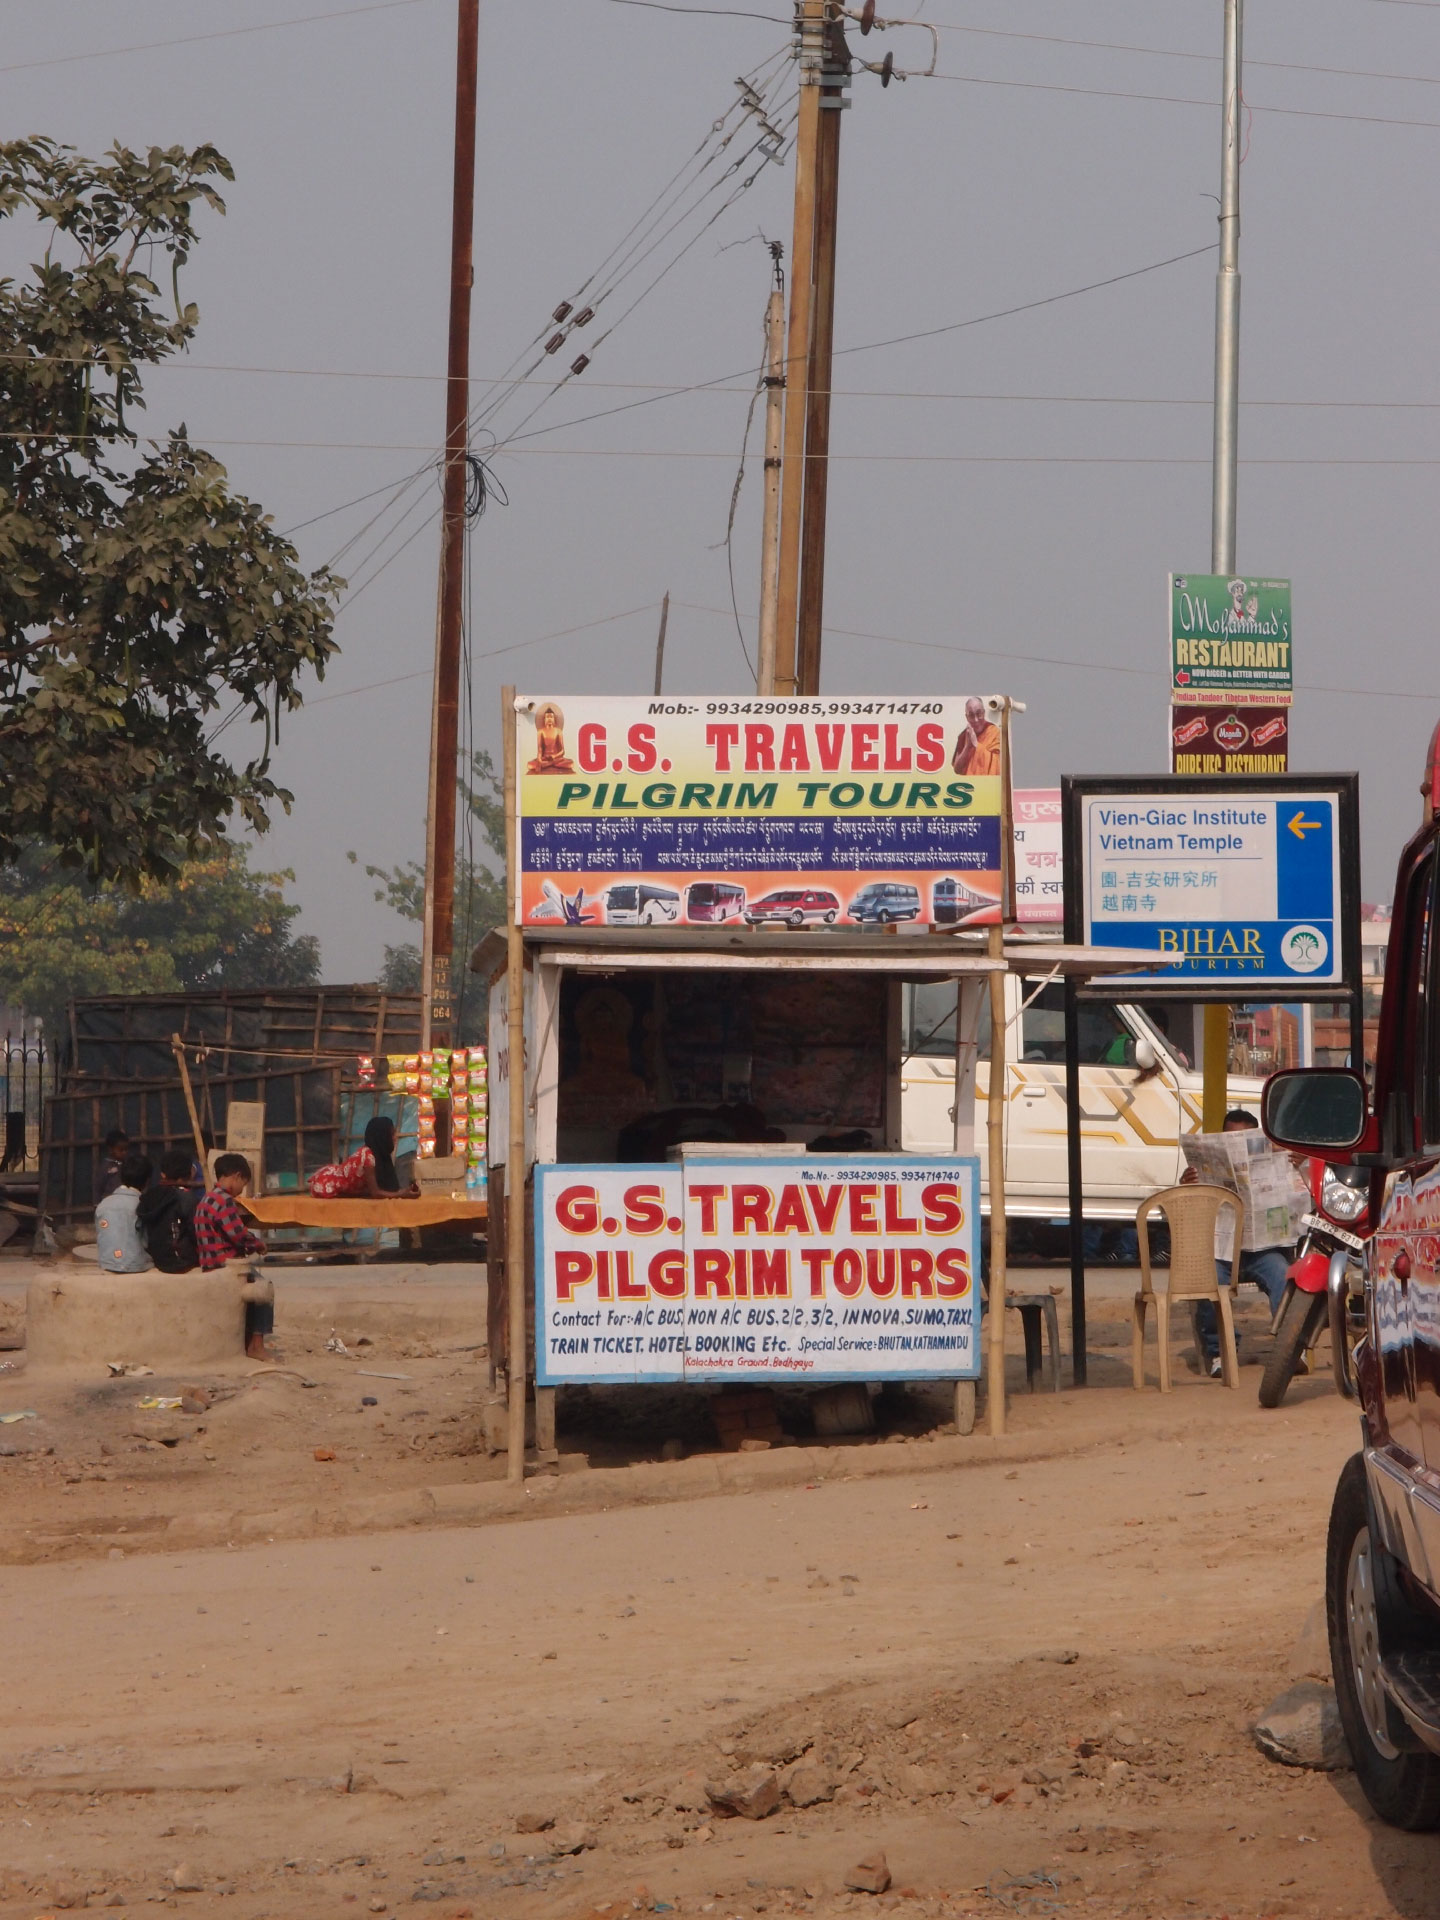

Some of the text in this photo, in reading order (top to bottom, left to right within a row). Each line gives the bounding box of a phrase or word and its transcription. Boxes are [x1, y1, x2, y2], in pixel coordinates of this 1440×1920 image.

[1179, 592, 1289, 645] Mohammad's
[1176, 638, 1290, 668] RESTAURANT
[1176, 692, 1196, 702] Indian
[1225, 693, 1248, 703] Tibetan
[1250, 694, 1276, 704] Western
[1276, 694, 1292, 704] Food
[1219, 727, 1242, 740] Magadh
[577, 722, 946, 774] G.S. TRAVELS
[557, 781, 975, 809] PILGRIM TOURS
[1099, 808, 1267, 826] Vien-Giac Institute
[1099, 834, 1243, 853] Vietnam Temple
[1102, 893, 1157, 912] 越南寺
[1158, 928, 1265, 954] BIHAR
[1172, 958, 1264, 970] OURISM
[901, 1171, 960, 1182] 9934714740
[554, 1182, 966, 1238] G.S. TRAVELS
[554, 1247, 972, 1303] PILGRIM TOURS
[552, 1310, 602, 1327] Contact
[688, 1308, 717, 1325] NON
[720, 1302, 742, 1327] A/C
[550, 1337, 590, 1355] TRAIN
[648, 1336, 692, 1353] HOTEL
[695, 1335, 756, 1353] BOOKING
[797, 1335, 836, 1354] Special
